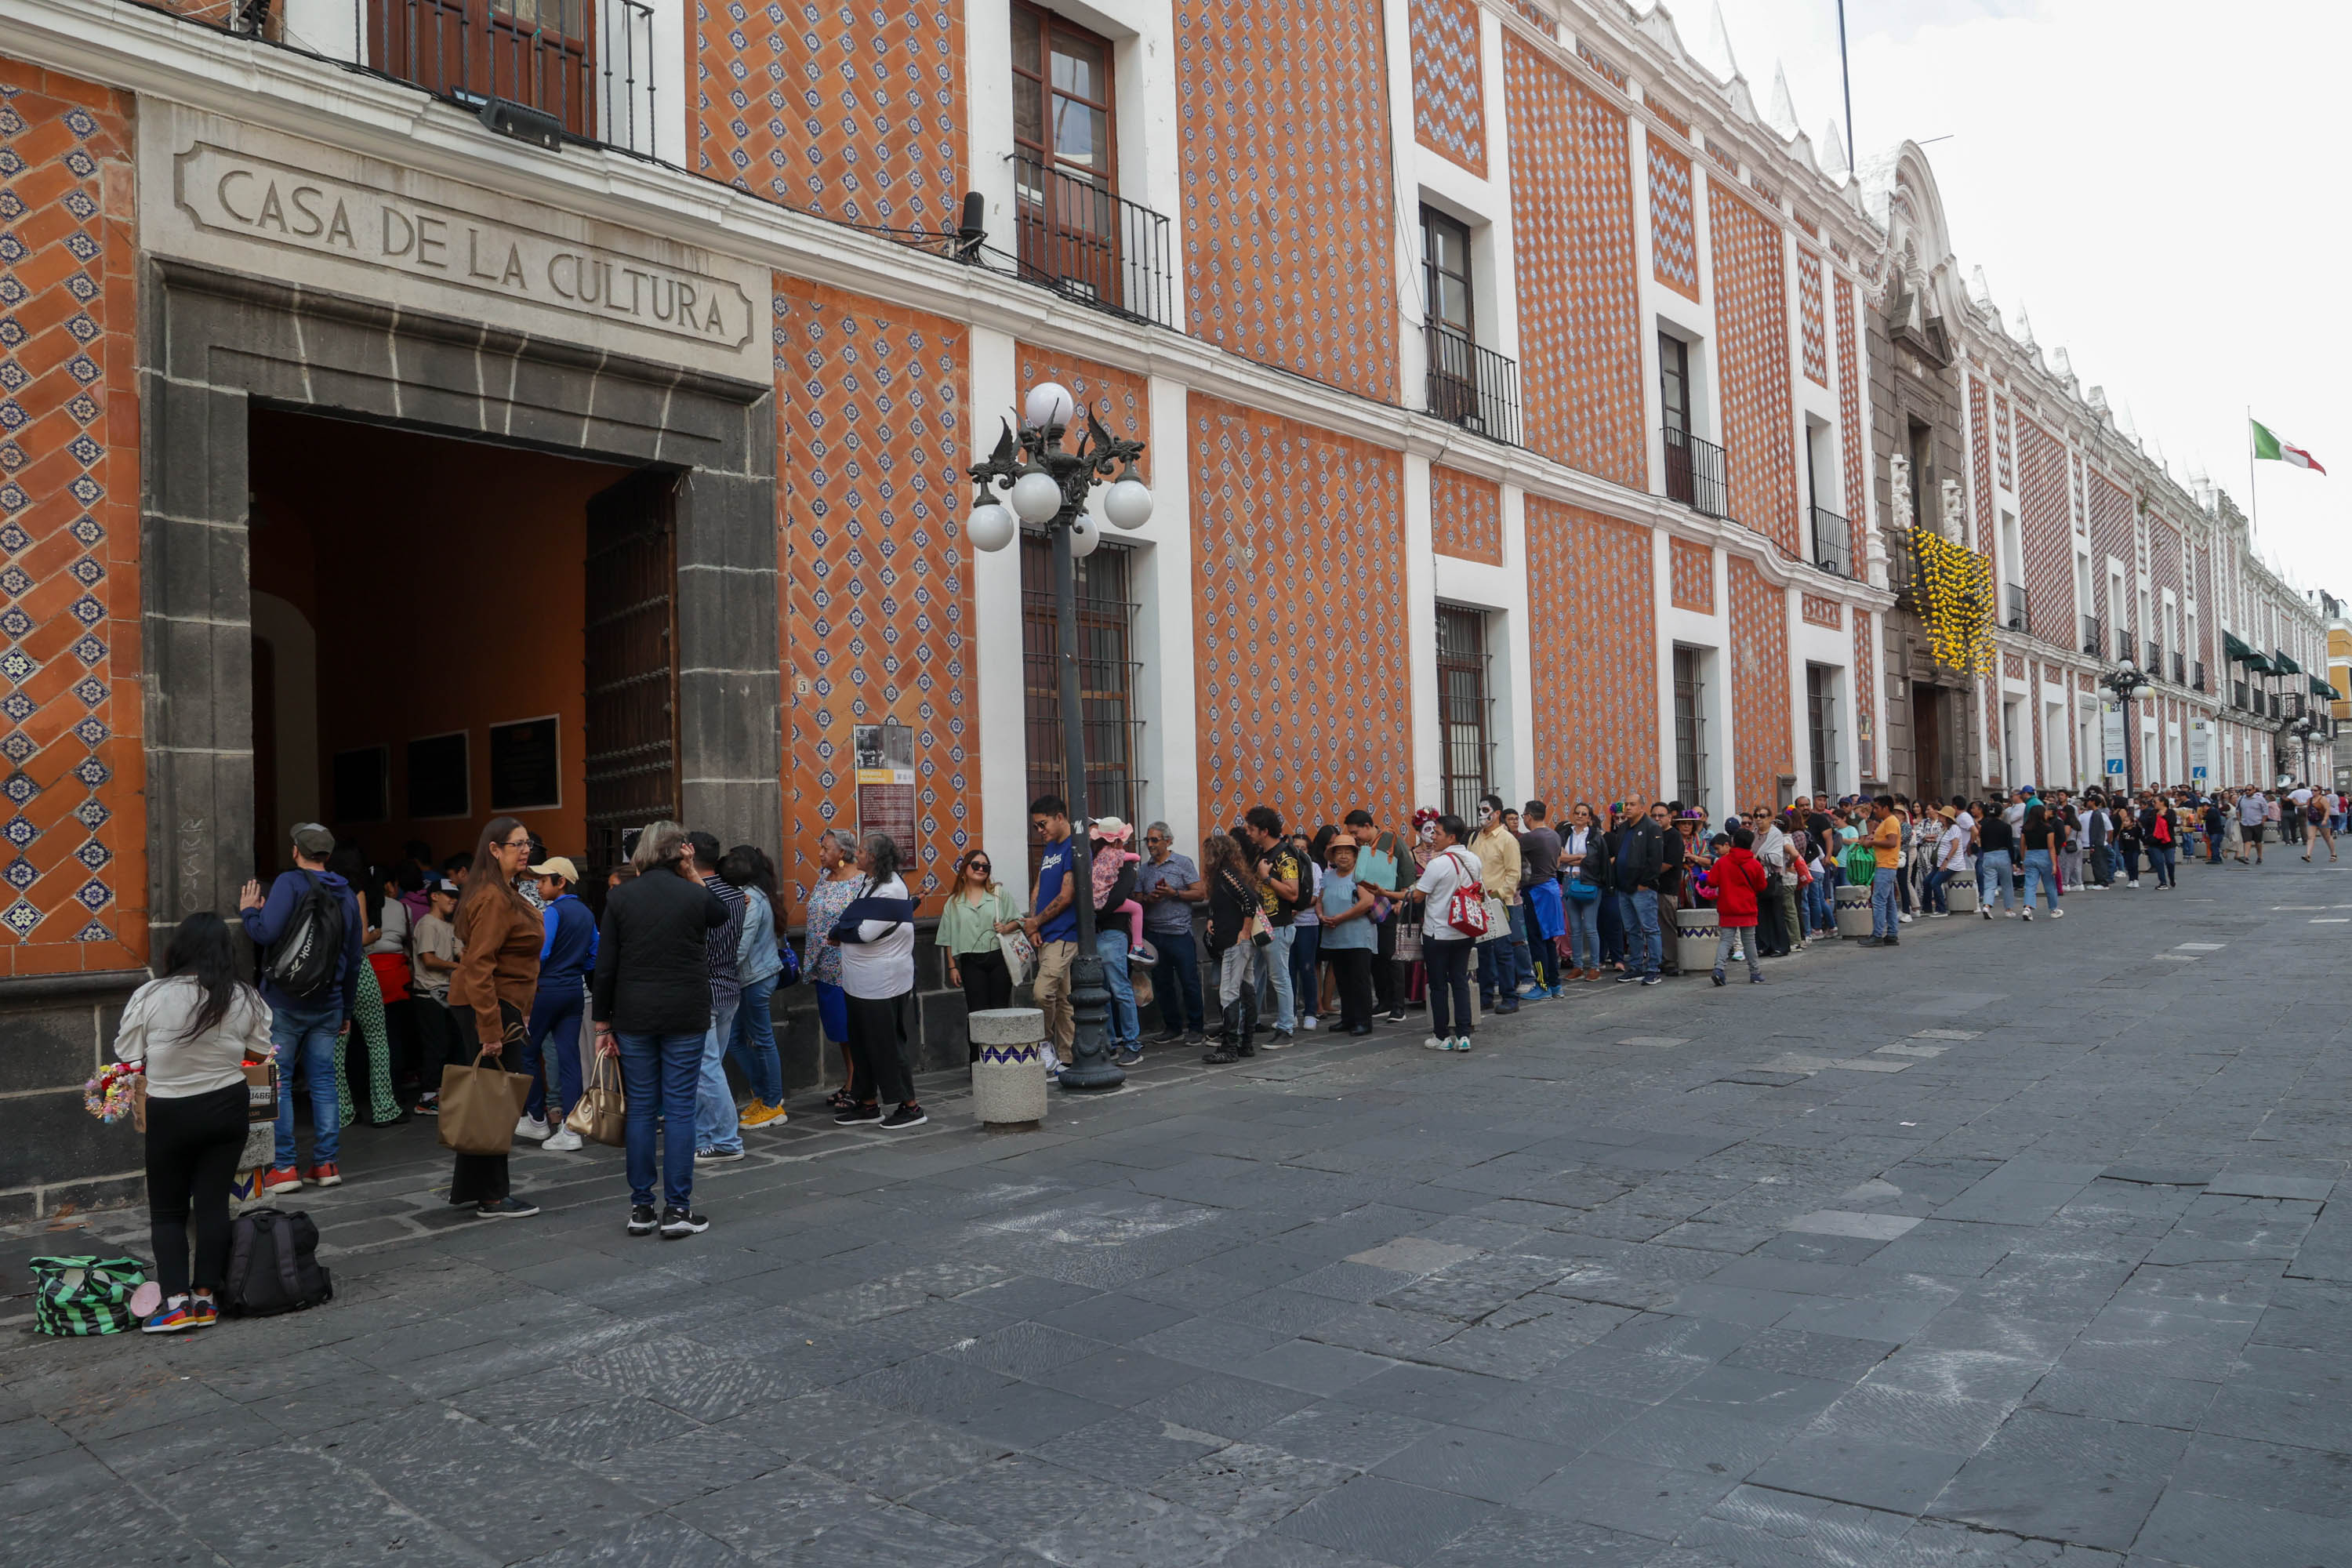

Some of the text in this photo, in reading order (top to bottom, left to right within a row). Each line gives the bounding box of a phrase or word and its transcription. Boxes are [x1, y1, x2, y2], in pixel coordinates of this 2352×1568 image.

[218, 170, 725, 336] CASA DE LA CULTURA
[800, 681, 806, 691] 5
